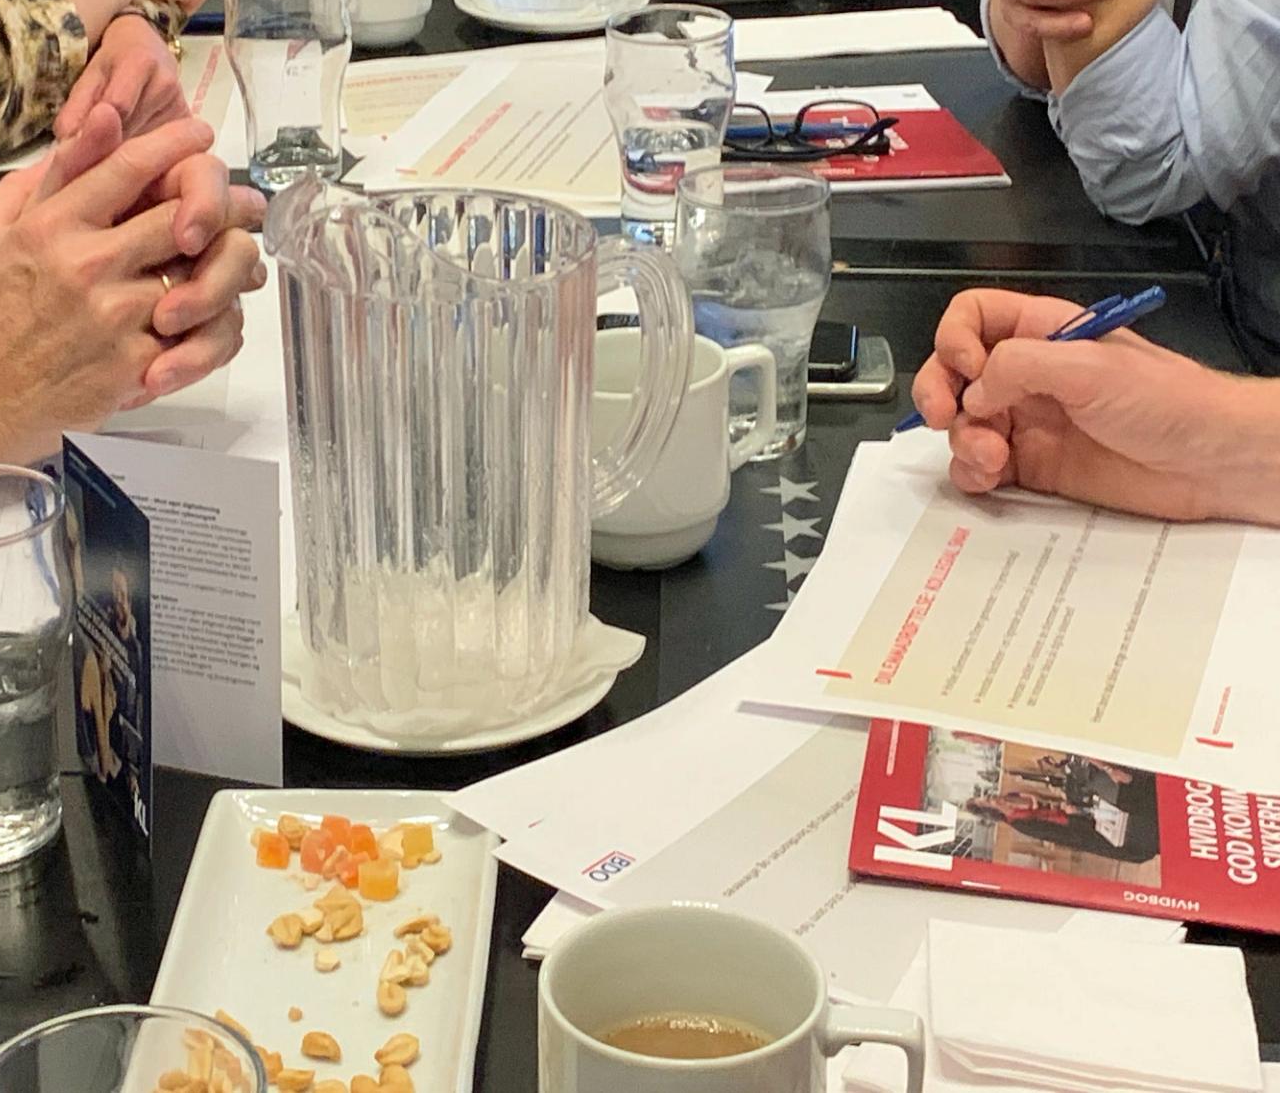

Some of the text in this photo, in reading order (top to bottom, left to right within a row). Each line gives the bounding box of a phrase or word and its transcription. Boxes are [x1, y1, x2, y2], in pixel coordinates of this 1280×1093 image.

[873, 800, 958, 872] KL
[1184, 780, 1219, 860] HVIDBOG
[588, 856, 631, 882] BDO
[1226, 839, 1259, 885] GOD
[1123, 890, 1200, 912] HVIDBOG
